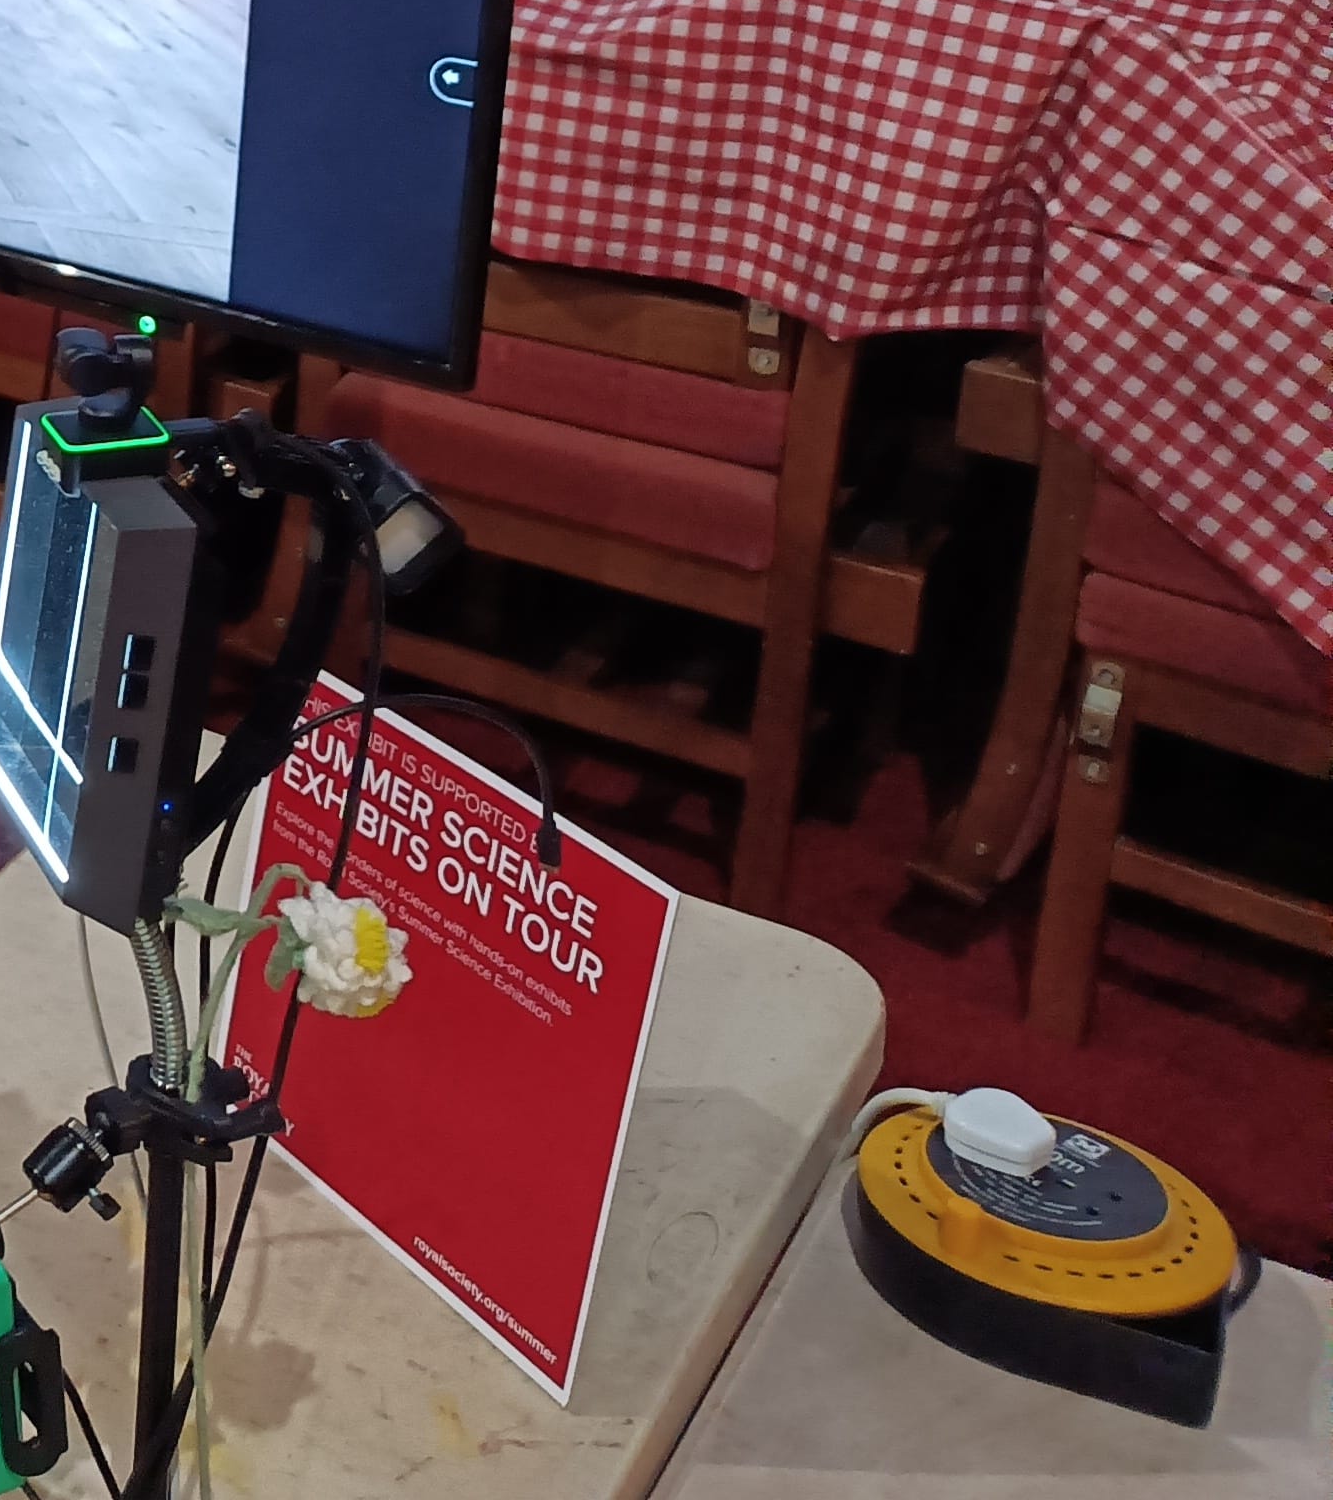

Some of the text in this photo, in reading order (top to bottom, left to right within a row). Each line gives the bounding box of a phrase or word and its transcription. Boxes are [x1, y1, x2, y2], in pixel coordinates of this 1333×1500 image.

[333, 715, 399, 762] EXIBIT
[400, 752, 418, 775] IS
[419, 763, 527, 843] SUPPORTED
[273, 818, 297, 844] from
[297, 836, 316, 858] the
[316, 848, 347, 879] Rol
[397, 905, 444, 946] Summer
[445, 939, 492, 981] Science
[493, 973, 554, 1028] Exhibition.
[275, 800, 315, 837] Explore
[316, 829, 334, 850] the
[384, 877, 398, 891] of
[398, 886, 442, 923] science
[443, 918, 468, 941] with
[468, 933, 524, 981] hands-on
[525, 976, 572, 1016] exhibits
[282, 752, 604, 994] EXHBITS ON TOUR
[439, 810, 598, 939] SCIENCE
[413, 1235, 558, 1366] royalsociety.org/summer
